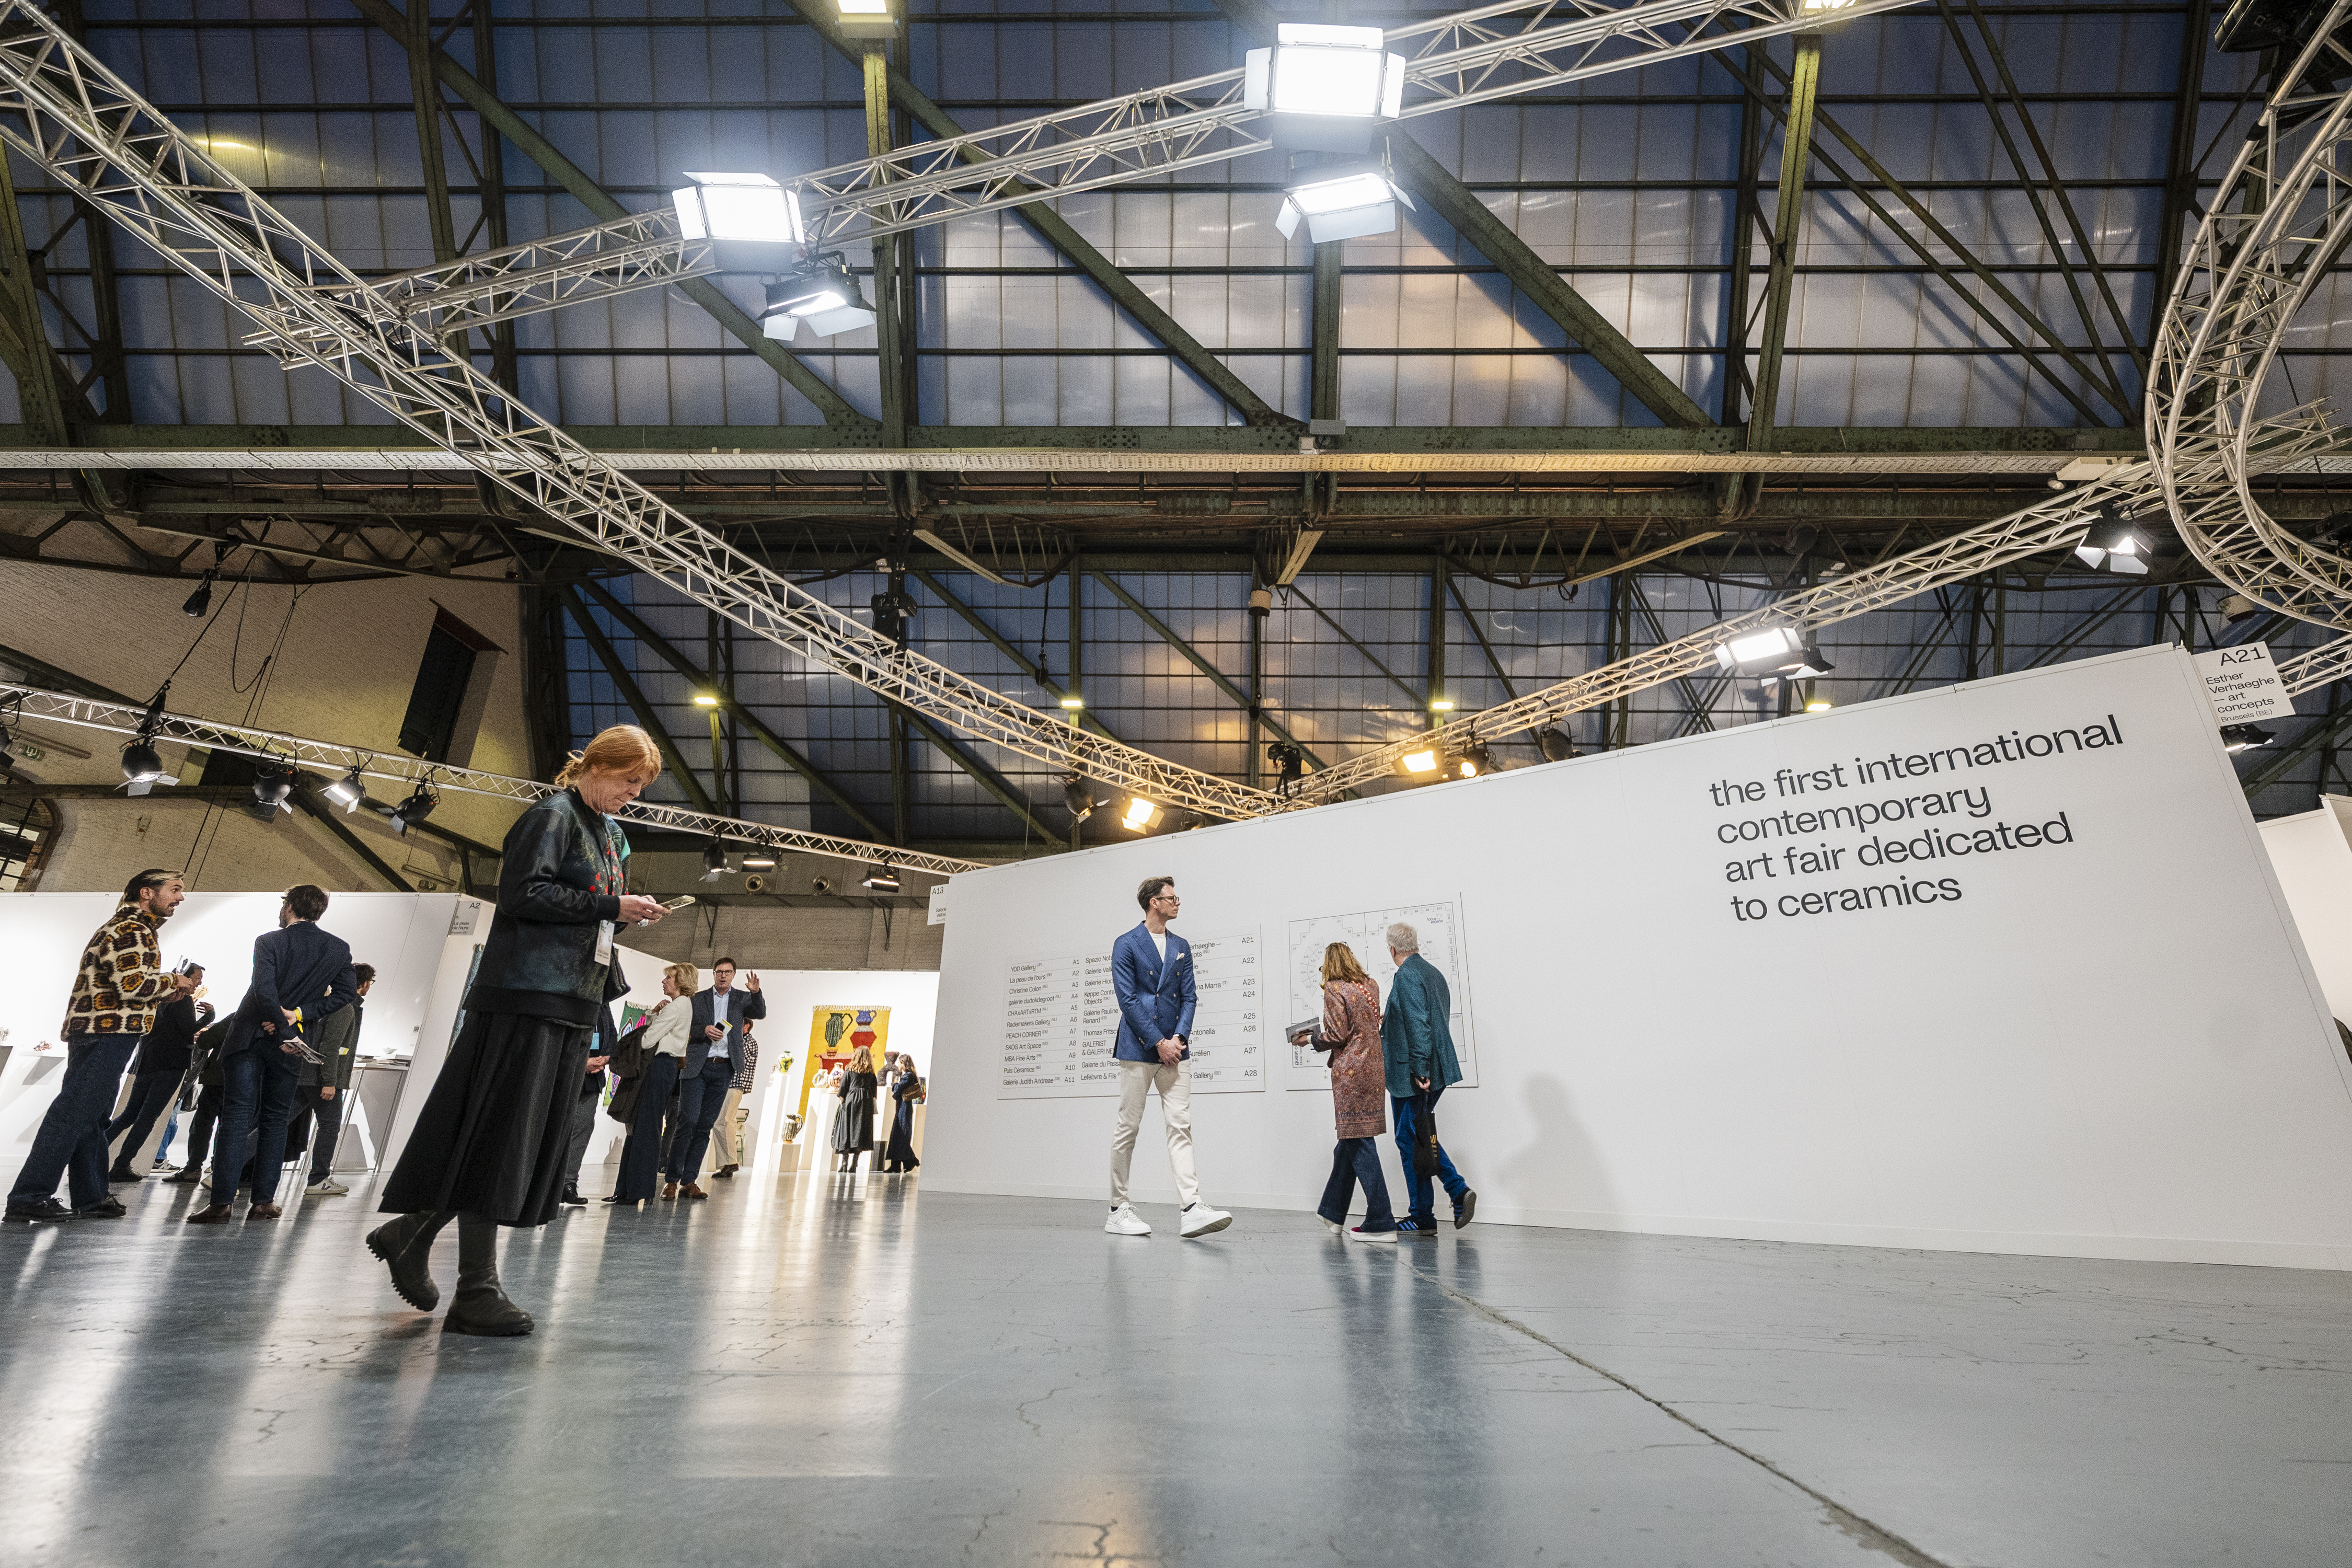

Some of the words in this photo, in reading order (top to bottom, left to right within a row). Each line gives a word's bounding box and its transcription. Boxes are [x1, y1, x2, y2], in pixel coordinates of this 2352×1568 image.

[2220, 647, 2266, 666] A21
[2206, 673, 2244, 685] Esther
[2209, 677, 2275, 694] Verhaeghe
[2228, 692, 2246, 701] art
[2218, 698, 2274, 713] concepts
[2221, 709, 2254, 722] Brussels
[2256, 708, 2273, 718] (BE)
[1709, 779, 1766, 807] the
[1773, 763, 1848, 797] first
[1855, 714, 2124, 784] international
[1717, 786, 1991, 844] contemporary
[1725, 851, 1776, 882] art
[1783, 843, 1847, 877] fair
[1858, 811, 2074, 867] dedicated
[1731, 894, 1767, 921] to
[1778, 875, 1962, 917] ceramics
[1190, 942, 1215, 950] erhaeghe
[1008, 998, 1023, 1007] galerie
[1024, 996, 1054, 1004] dudokdegroot
[1008, 1008, 1042, 1017] CHAxARTxRTM
